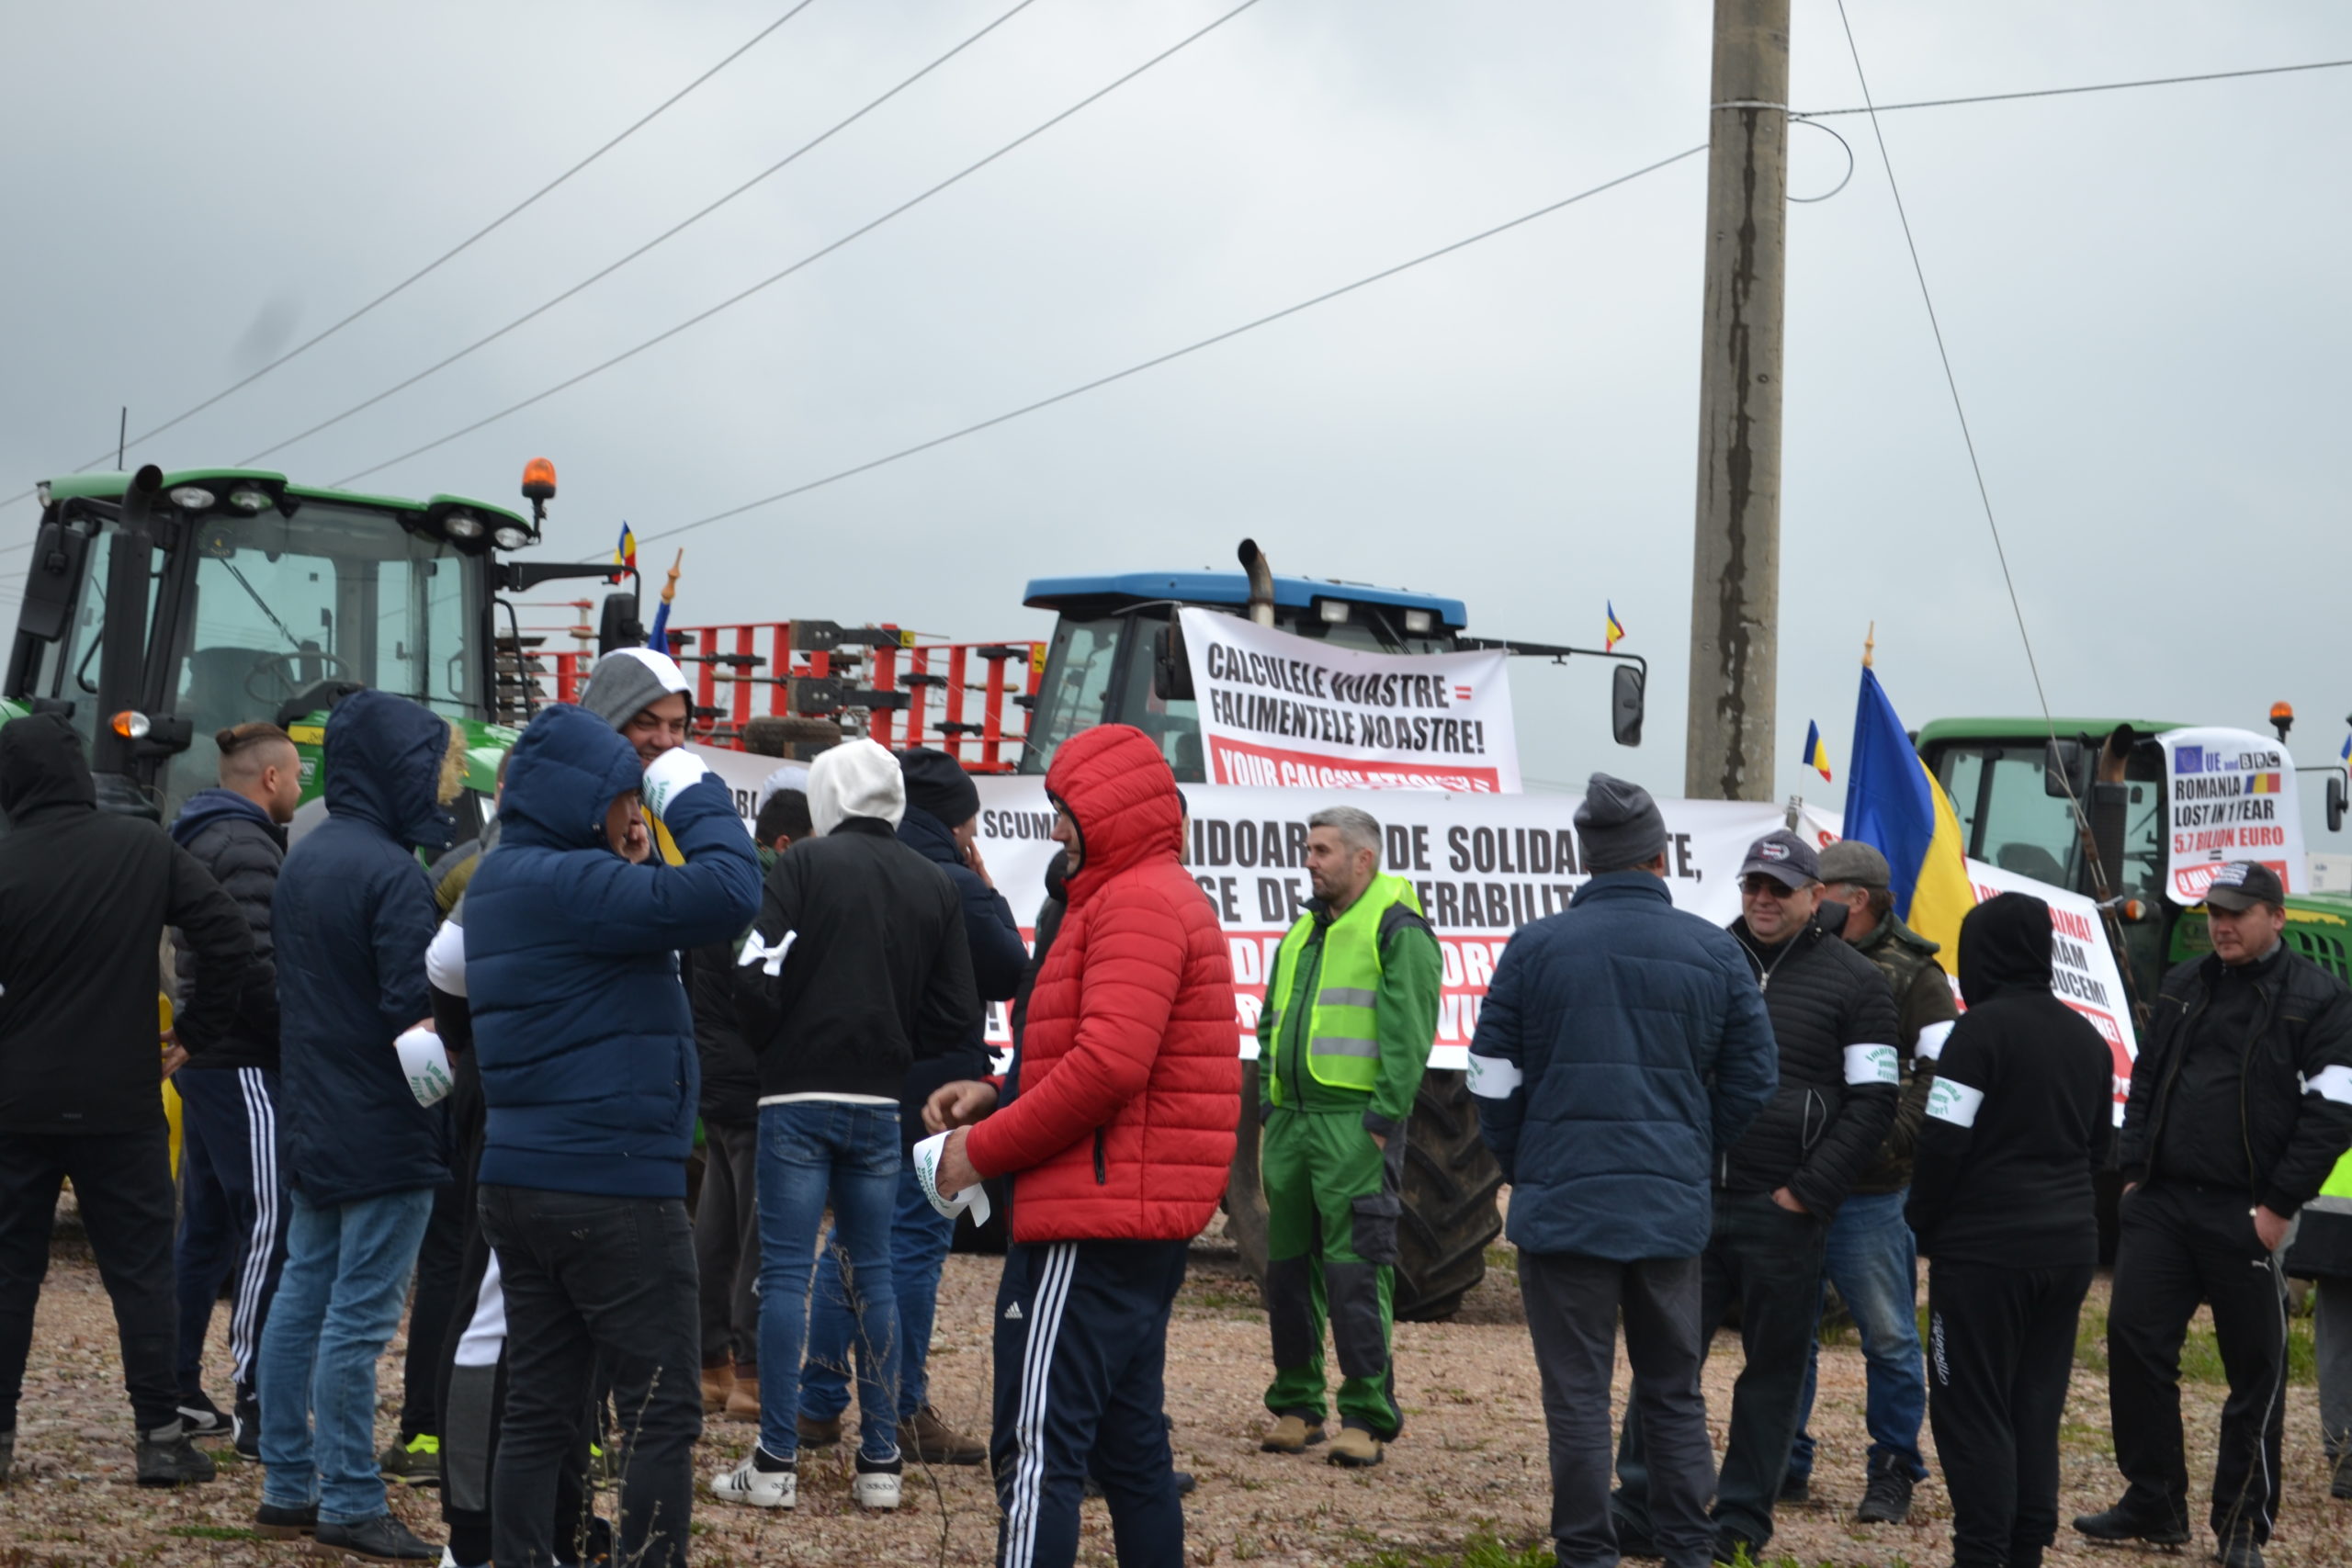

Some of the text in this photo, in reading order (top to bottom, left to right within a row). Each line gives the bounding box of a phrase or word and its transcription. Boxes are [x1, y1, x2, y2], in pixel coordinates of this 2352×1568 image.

[1207, 641, 1473, 708] CALCULELE VOASTRE =
[1210, 687, 1486, 754] FALIMENTELE NOASTRE!
[1218, 747, 1275, 786] YOUR
[2205, 752, 2222, 773] UE
[2175, 775, 2241, 801] ROMANIA
[983, 810, 1059, 840] SCUM
[2175, 805, 2211, 828] LOST
[2211, 802, 2227, 824] IN
[2235, 798, 2275, 821] YEAR
[1185, 818, 1308, 868] IDOAR
[1385, 824, 1431, 871] DE
[2175, 825, 2285, 854] 5.7 BILION EURO
